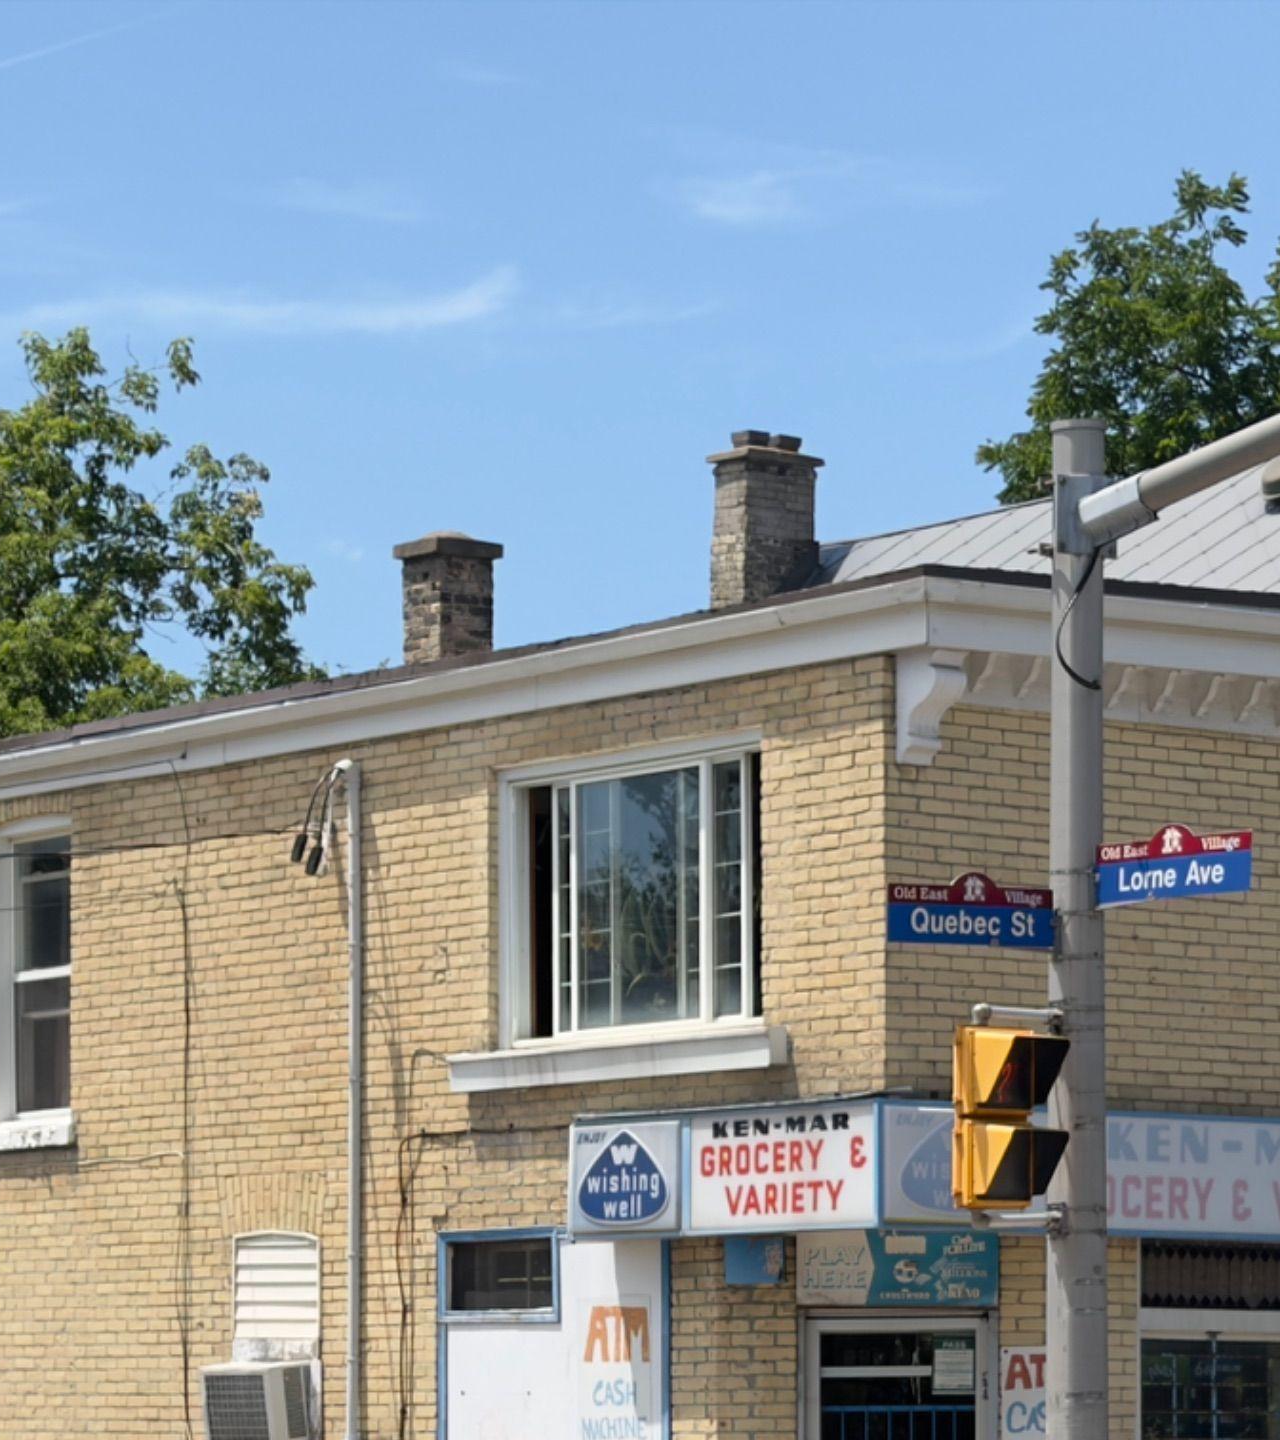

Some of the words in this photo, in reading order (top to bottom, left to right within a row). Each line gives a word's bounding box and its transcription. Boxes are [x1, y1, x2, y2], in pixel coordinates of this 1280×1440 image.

[1101, 846, 1120, 860] Old
[1123, 845, 1149, 859] East
[1201, 836, 1241, 851] Village
[1118, 867, 1177, 893] Lorne
[1184, 859, 1225, 886] Ave
[894, 886, 917, 899] Old
[920, 887, 948, 901] East
[1005, 890, 1043, 908] Village
[910, 907, 1001, 936] Quebec
[1011, 911, 1035, 937] St
[576, 1132, 607, 1144] ENJOY
[712, 1112, 850, 1138] KEN-MAR
[700, 1138, 824, 1177] GROCERY
[850, 1135, 867, 1169] &
[587, 1167, 660, 1198] wishing
[725, 1179, 844, 1216] VARIETY
[603, 1194, 642, 1218] well
[1231, 1179, 1252, 1222] &
[803, 1246, 866, 1266] PLAY
[802, 1269, 867, 1289] HERE
[583, 1306, 651, 1362] ATM
[1005, 1354, 1046, 1390] AT
[592, 1379, 637, 1407] CASH
[1006, 1401, 1046, 1433] CAS
